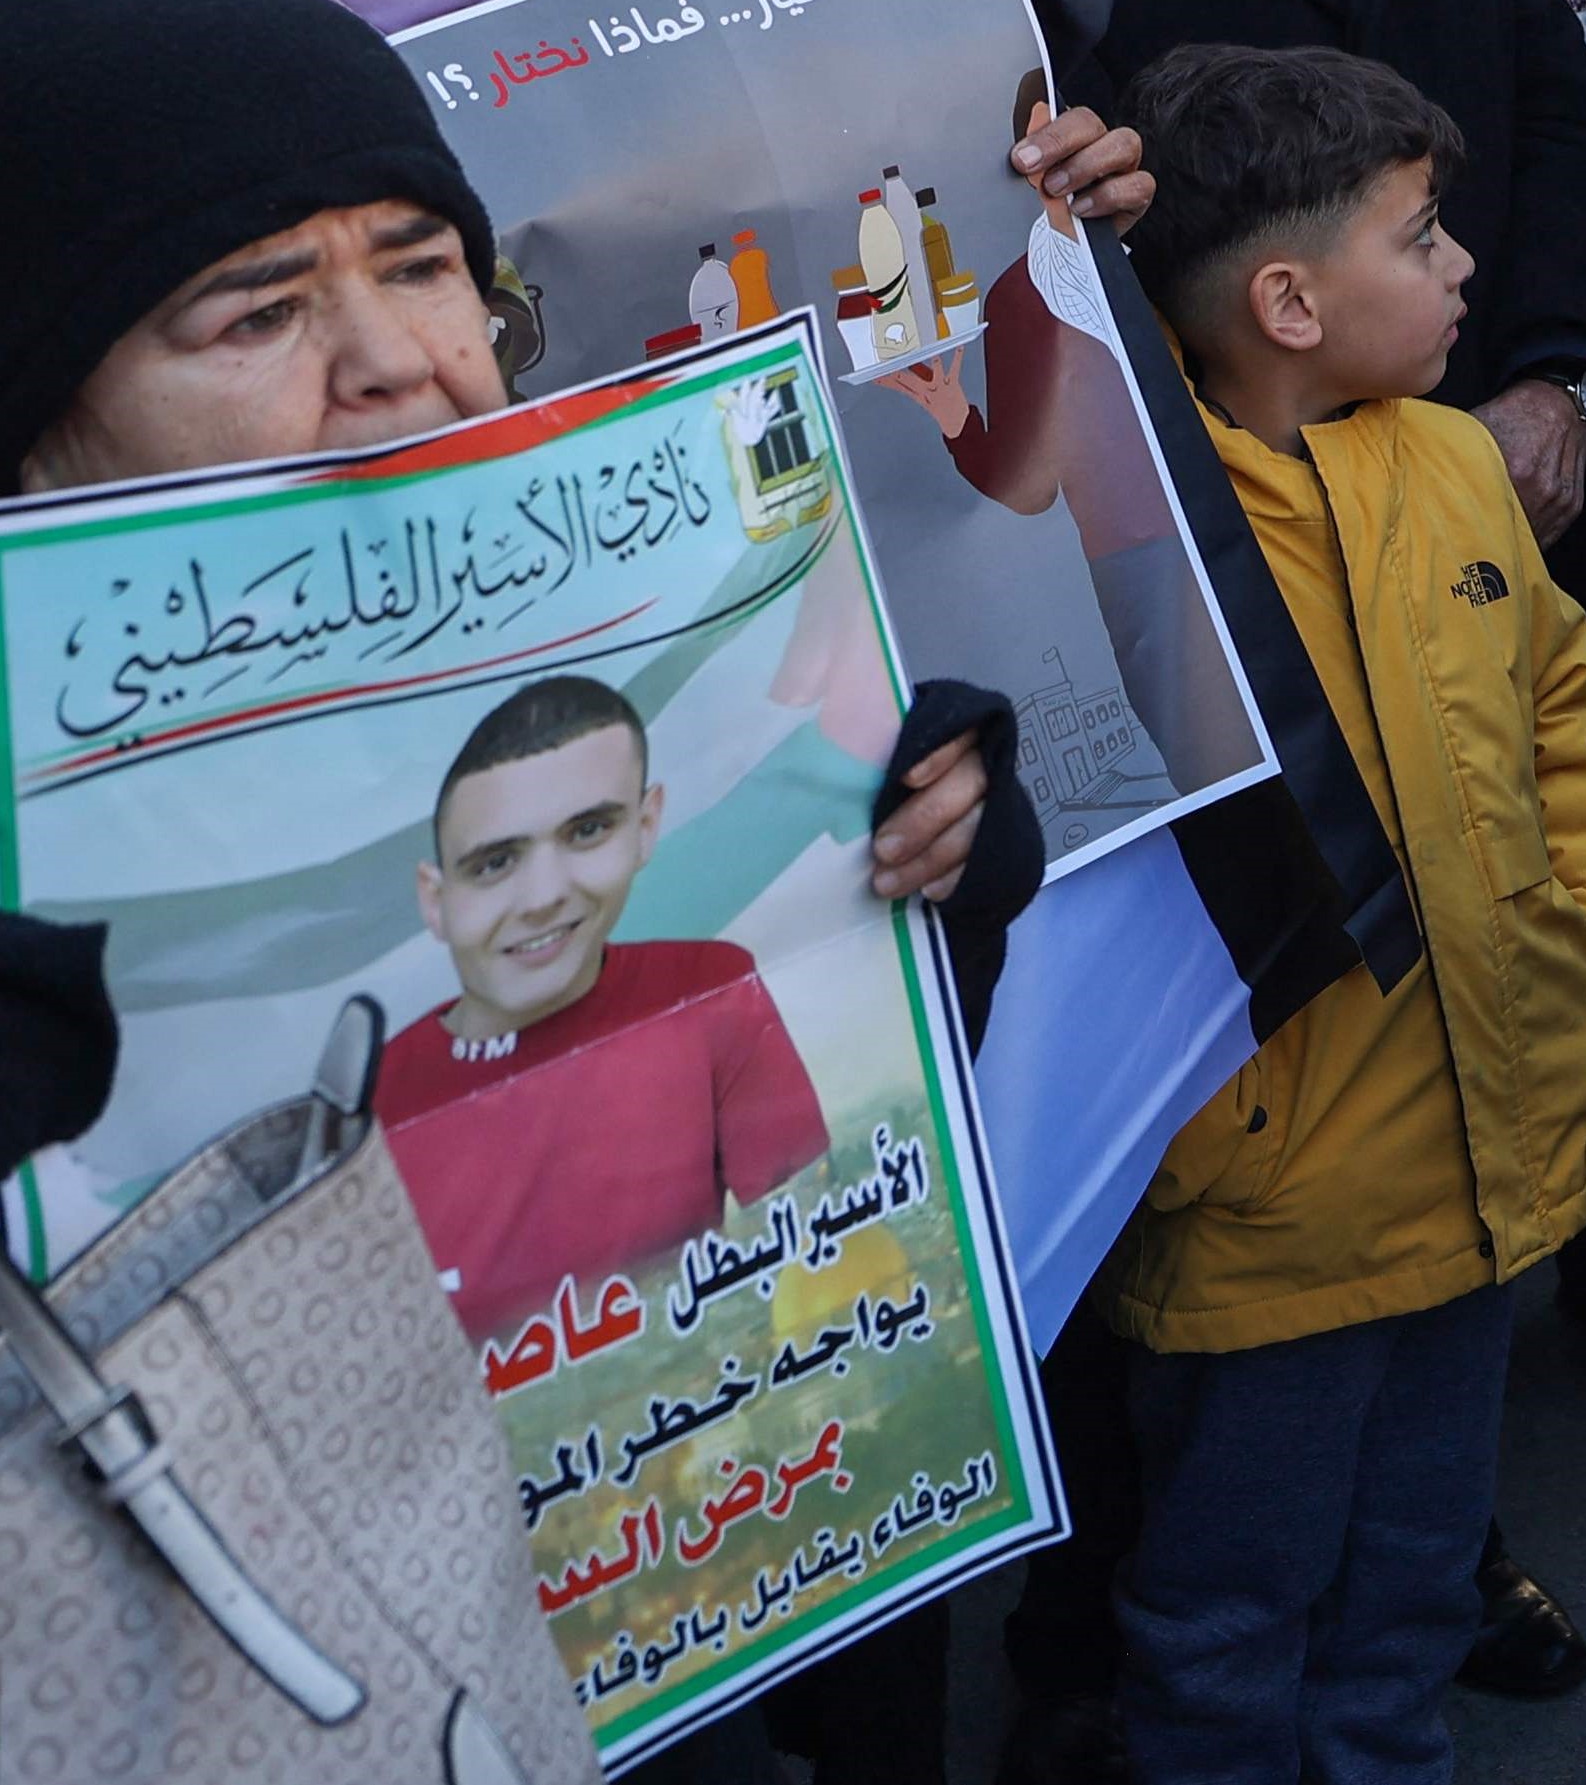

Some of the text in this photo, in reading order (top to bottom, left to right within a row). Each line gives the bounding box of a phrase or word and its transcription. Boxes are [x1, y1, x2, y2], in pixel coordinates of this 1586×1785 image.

[486, 36, 592, 109] نختار
[485, 1120, 930, 1401] الأسير البطل عاص
[768, 1281, 934, 1389] يواجه
[612, 1352, 762, 1484] خطر
[675, 1416, 854, 1564] بمرض
[869, 1450, 997, 1559] الوفاء
[739, 1527, 863, 1633] يقابل
